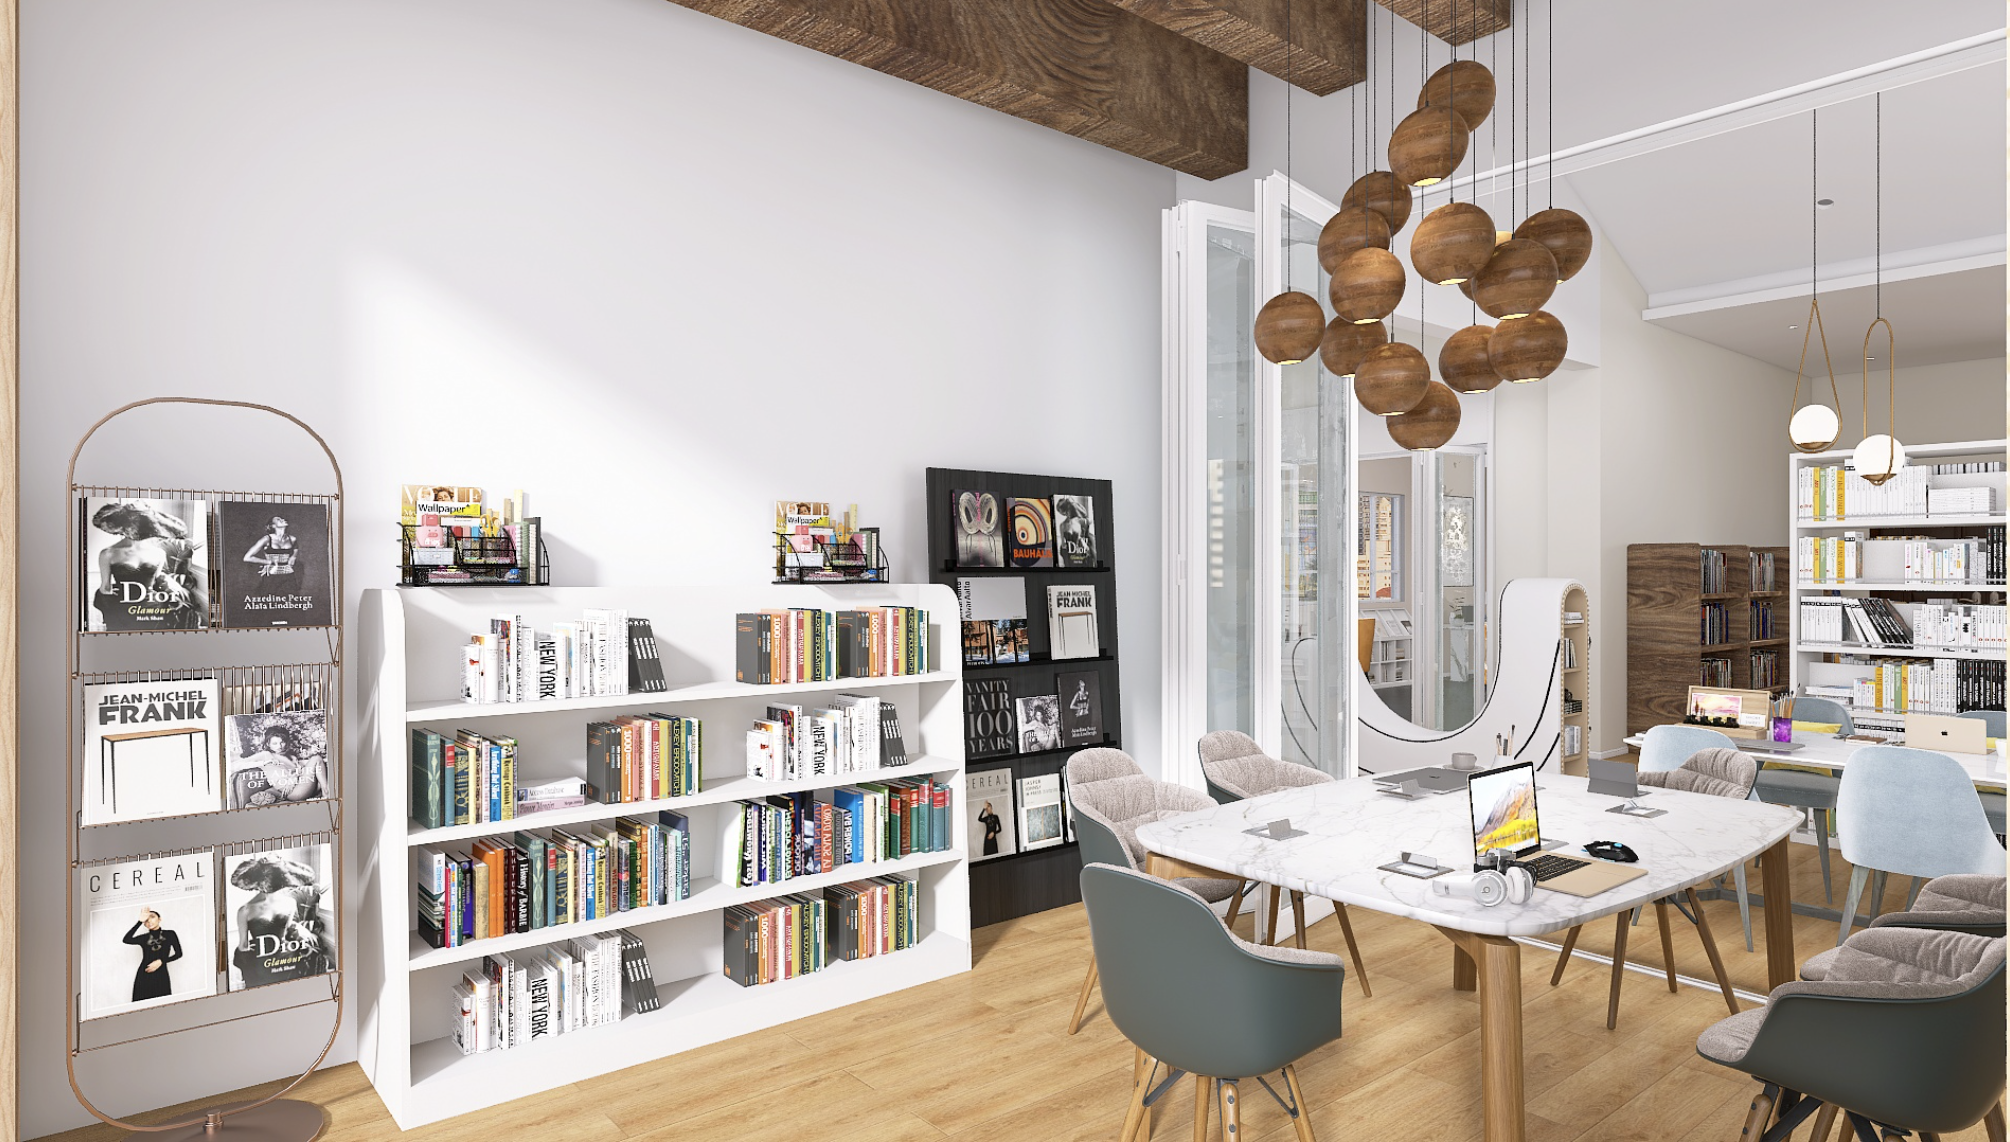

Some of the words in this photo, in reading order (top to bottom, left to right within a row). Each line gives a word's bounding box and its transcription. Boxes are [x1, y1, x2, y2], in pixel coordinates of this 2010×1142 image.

[402, 485, 482, 505] VOUE
[1013, 548, 1053, 558] BAUHAUS
[1068, 540, 1090, 554] Dior
[119, 581, 179, 604] Dior
[244, 593, 287, 603] Azzedine
[288, 594, 313, 603] Peter
[1056, 597, 1092, 608] FRANK
[127, 605, 172, 615] Glamour
[268, 601, 313, 611] Lindbergh
[773, 617, 781, 638] 1000
[539, 641, 556, 665] NEW
[539, 669, 556, 698] YORK
[966, 679, 1010, 694] VANITY
[98, 690, 207, 706] JEAN-MICHEL
[967, 692, 1011, 713] FAIR
[98, 700, 207, 726] FRANK
[968, 710, 1013, 739] 100
[624, 729, 632, 753] 1000
[812, 726, 826, 747] NEW
[969, 735, 1013, 753] YEARS
[813, 750, 825, 776] YORK
[247, 779, 265, 789] OF
[89, 861, 205, 893] CEREAL
[517, 863, 528, 889] History
[518, 898, 528, 927] BARBIE
[255, 934, 309, 959] Dior
[263, 955, 302, 968] Glamour
[531, 978, 548, 1004] NEW
[531, 1004, 549, 1038] YORK
